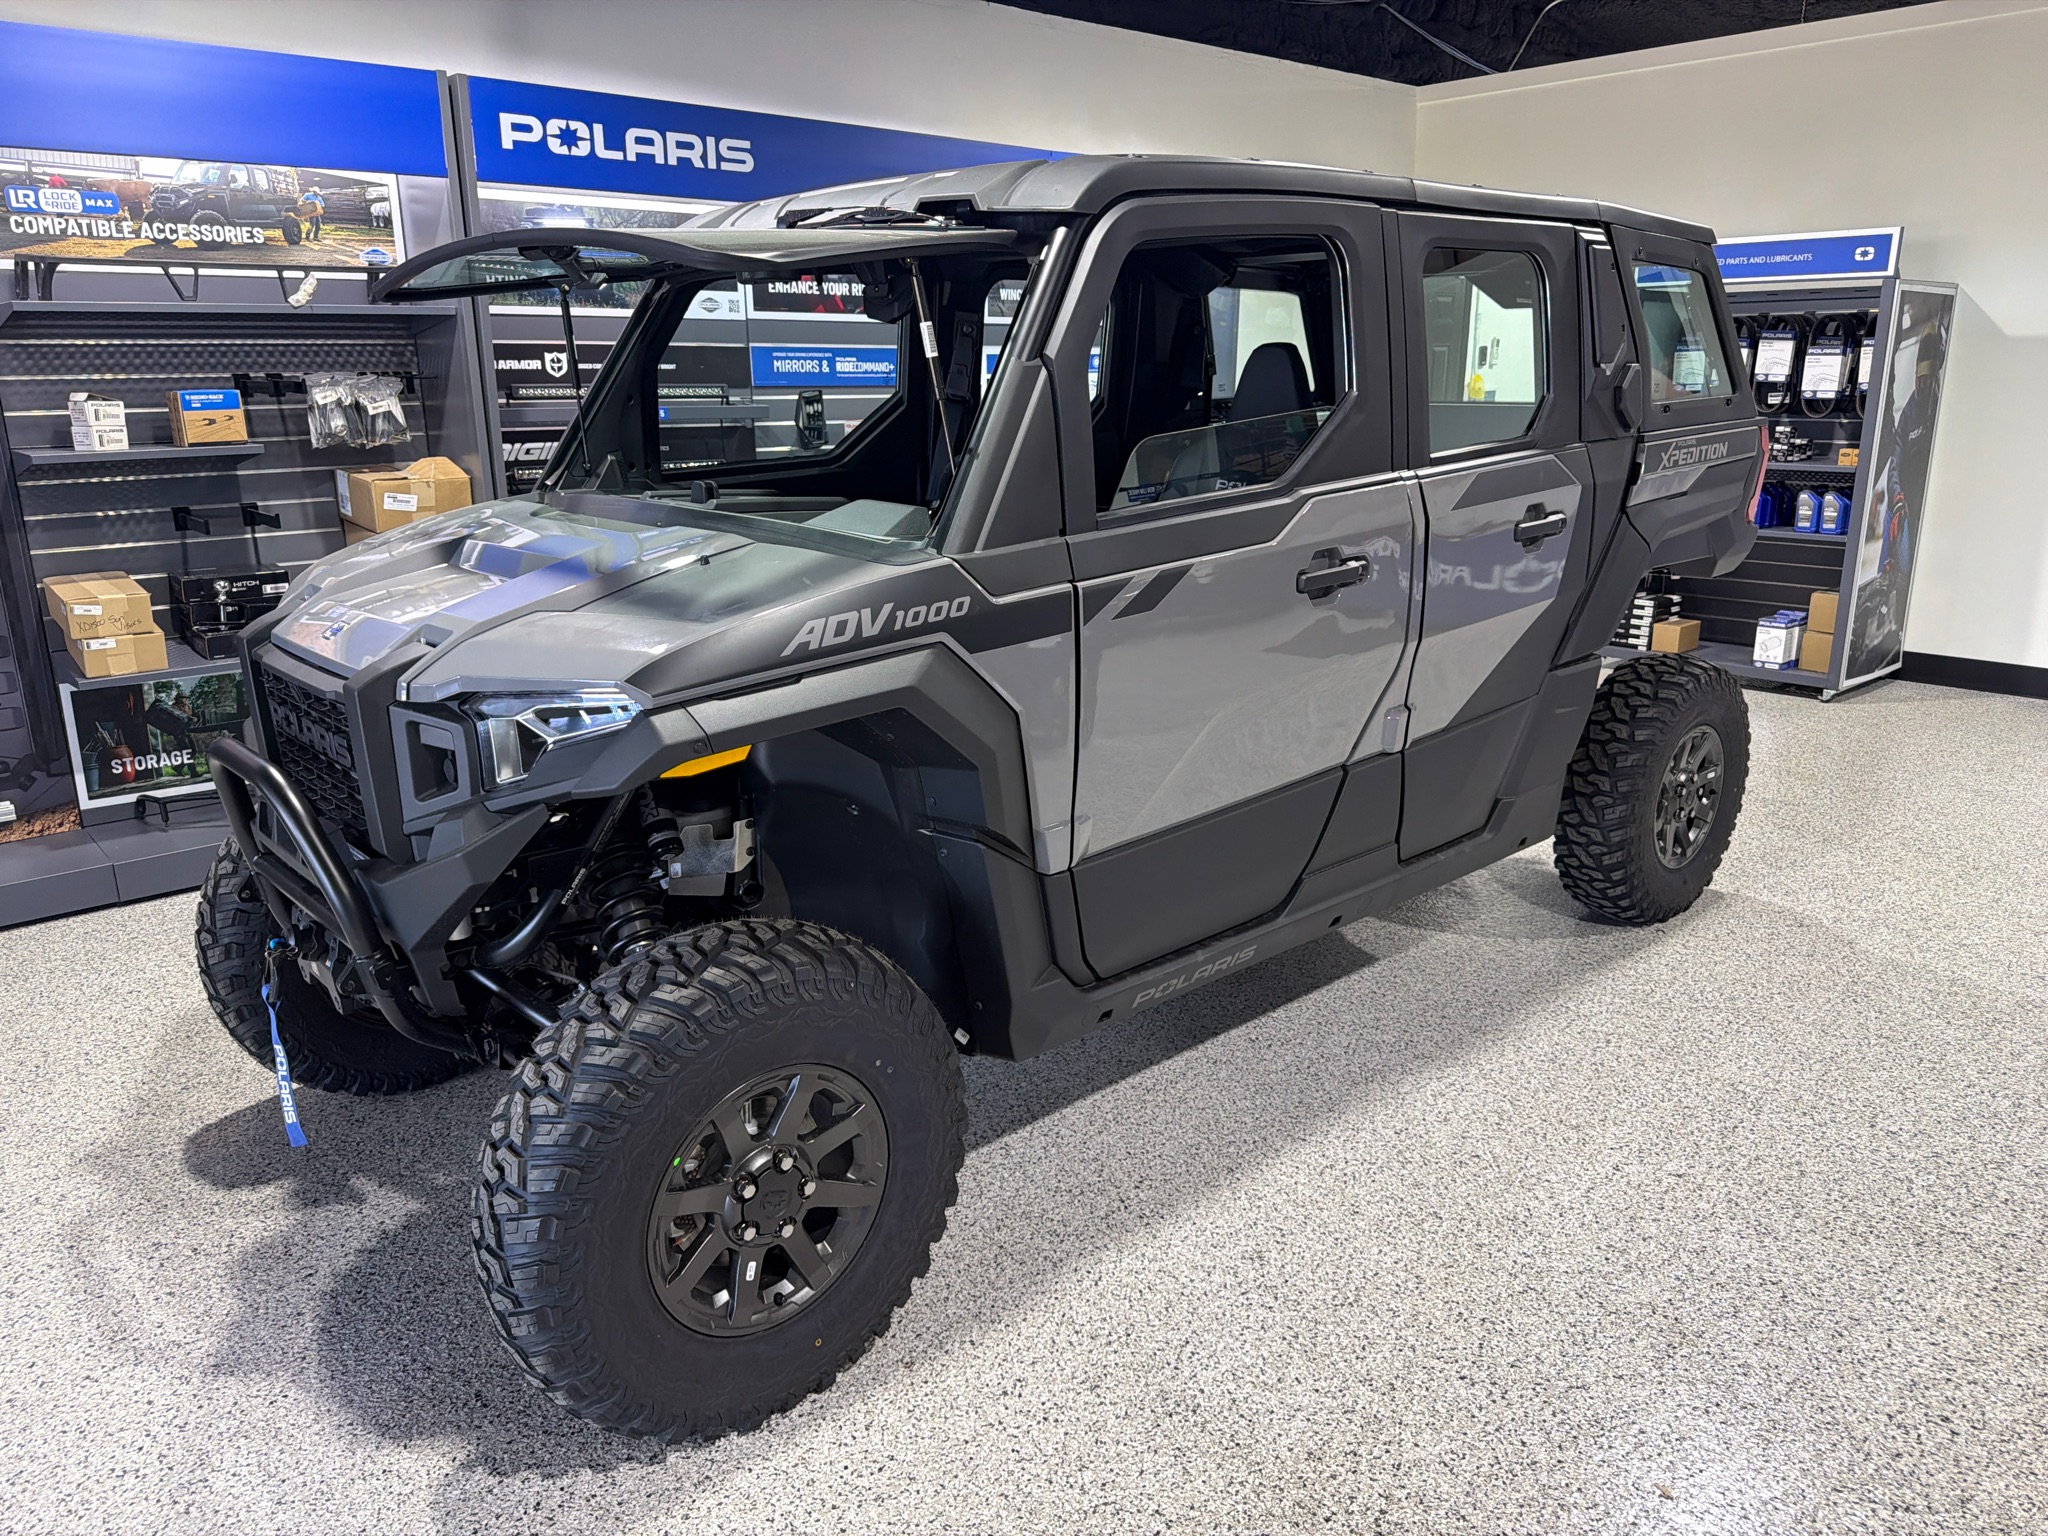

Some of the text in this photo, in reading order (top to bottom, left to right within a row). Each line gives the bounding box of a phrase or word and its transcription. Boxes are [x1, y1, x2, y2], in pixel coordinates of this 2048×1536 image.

[498, 112, 755, 173] POLARIS
[43, 191, 76, 201] LOCK
[85, 198, 113, 208] MAX
[9, 215, 265, 244] COMPATIBLE ACCESSORIES
[1725, 257, 1748, 266] PARTS
[1749, 256, 1766, 265] AND
[1766, 253, 1813, 263] LUBRICANTS
[767, 280, 820, 295] ENHANCE
[821, 282, 850, 296] YOUR
[498, 359, 542, 370] ARMOR
[773, 360, 830, 373] MIRRORS &
[1657, 441, 1729, 472] XPEDITION
[233, 580, 260, 588] HITCH
[779, 595, 972, 658] ADV 1000
[1758, 620, 1786, 628] POLARIS
[269, 698, 352, 769] POLARIS
[110, 748, 194, 775] STORAGE
[1131, 944, 1258, 1009] POLARIS
[273, 1043, 298, 1125] POLARIS
